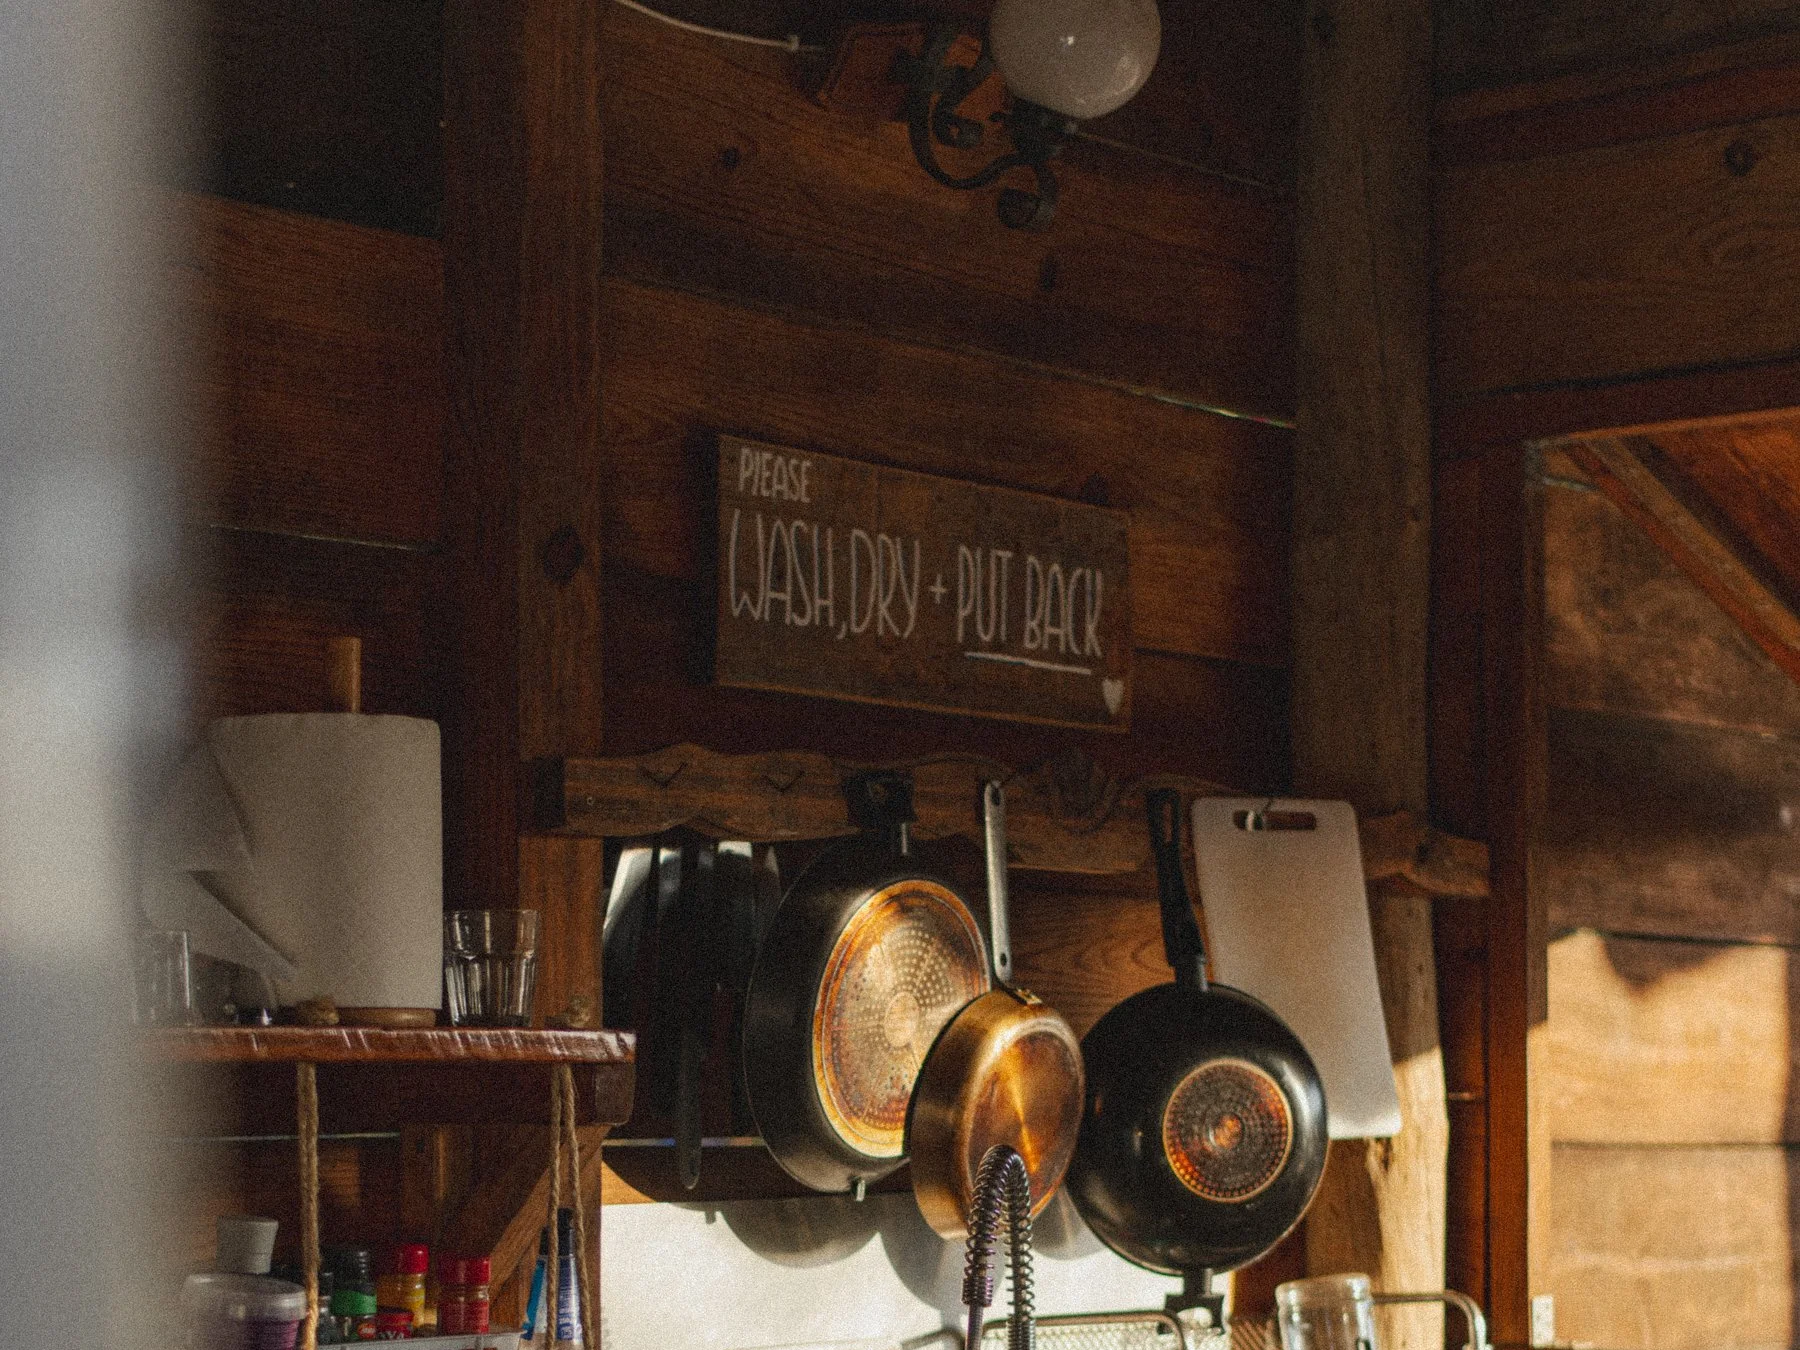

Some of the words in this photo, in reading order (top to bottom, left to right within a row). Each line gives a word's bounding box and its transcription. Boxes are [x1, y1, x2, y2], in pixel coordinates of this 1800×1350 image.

[738, 448, 813, 503] PLEASE
[957, 545, 1013, 643] PUT
[1023, 555, 1103, 656] BACK
